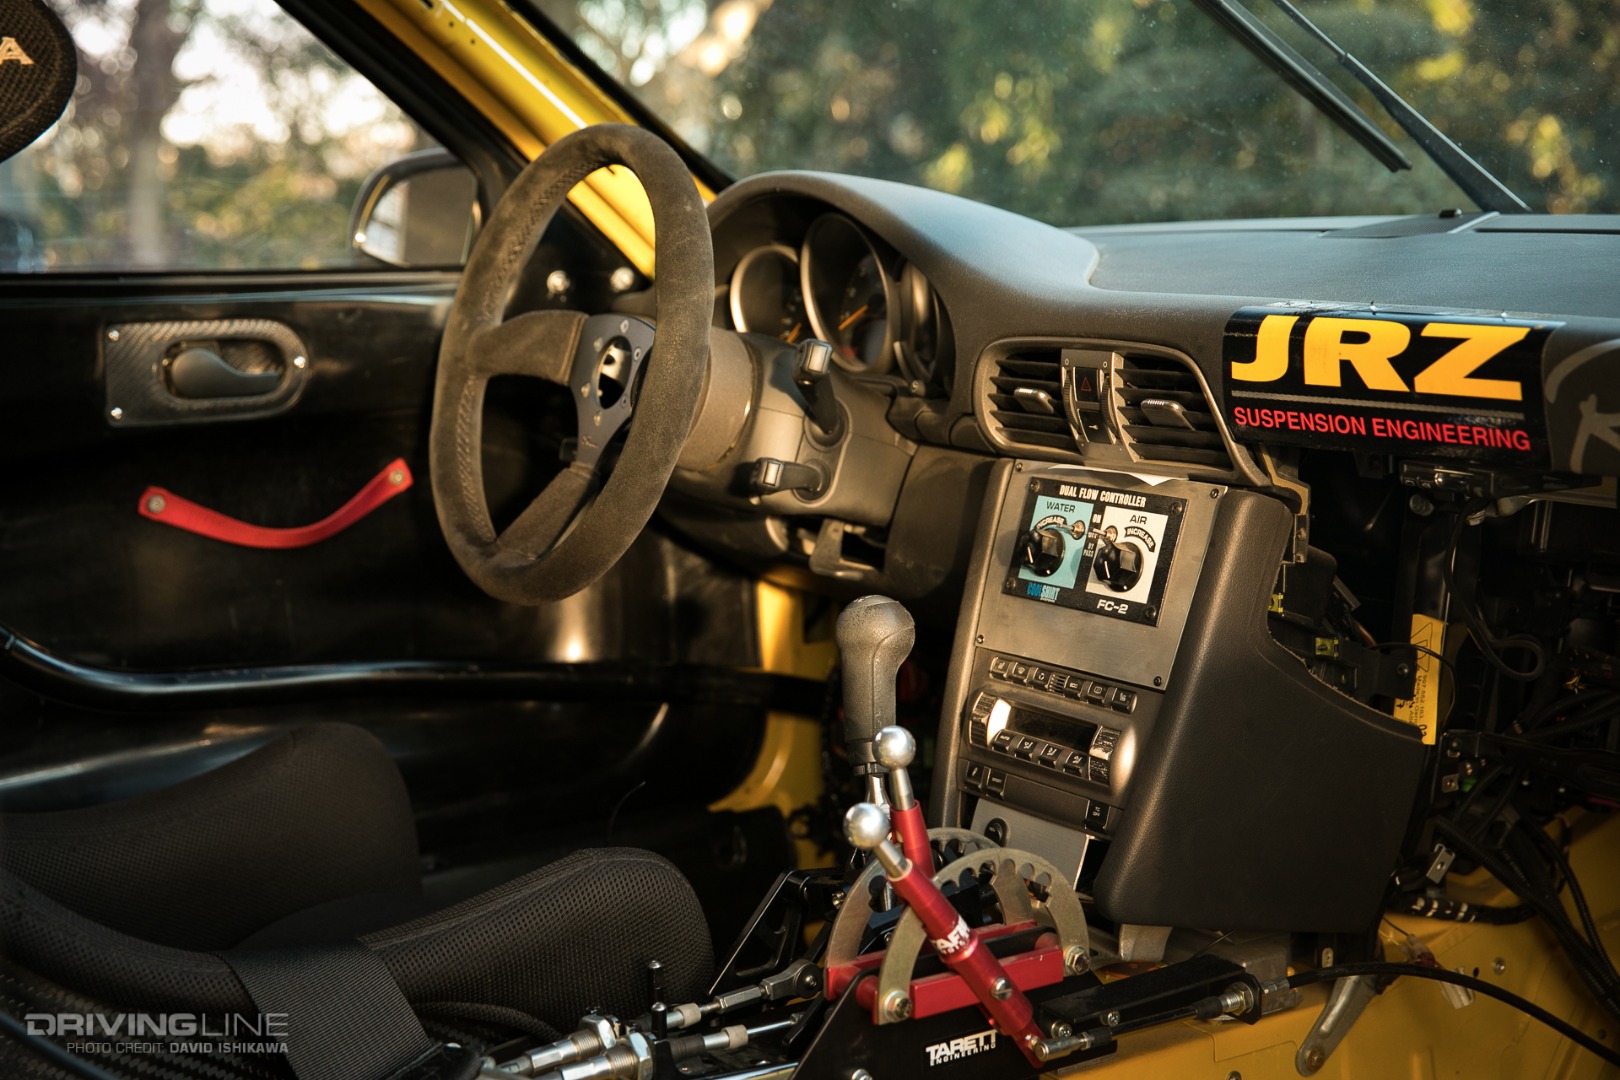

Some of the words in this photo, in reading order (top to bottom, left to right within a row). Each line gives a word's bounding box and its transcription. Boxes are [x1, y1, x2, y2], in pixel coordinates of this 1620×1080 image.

[1231, 314, 1531, 401] JRZ
[1234, 406, 1367, 436] SUSPENSION
[1372, 417, 1531, 451] ENGINEERING
[1046, 501, 1076, 513] WATER
[1059, 484, 1077, 498] DUAL
[1079, 487, 1099, 501] FLOW
[1100, 491, 1147, 508] CONTROLLER
[1092, 513, 1102, 524] ON
[1129, 514, 1148, 525] AIR
[1126, 528, 1155, 549] INCREASE
[1096, 599, 1129, 615] FC-2
[925, 1029, 998, 1061] TARETT
[930, 1042, 997, 1067] ENGINEERING
